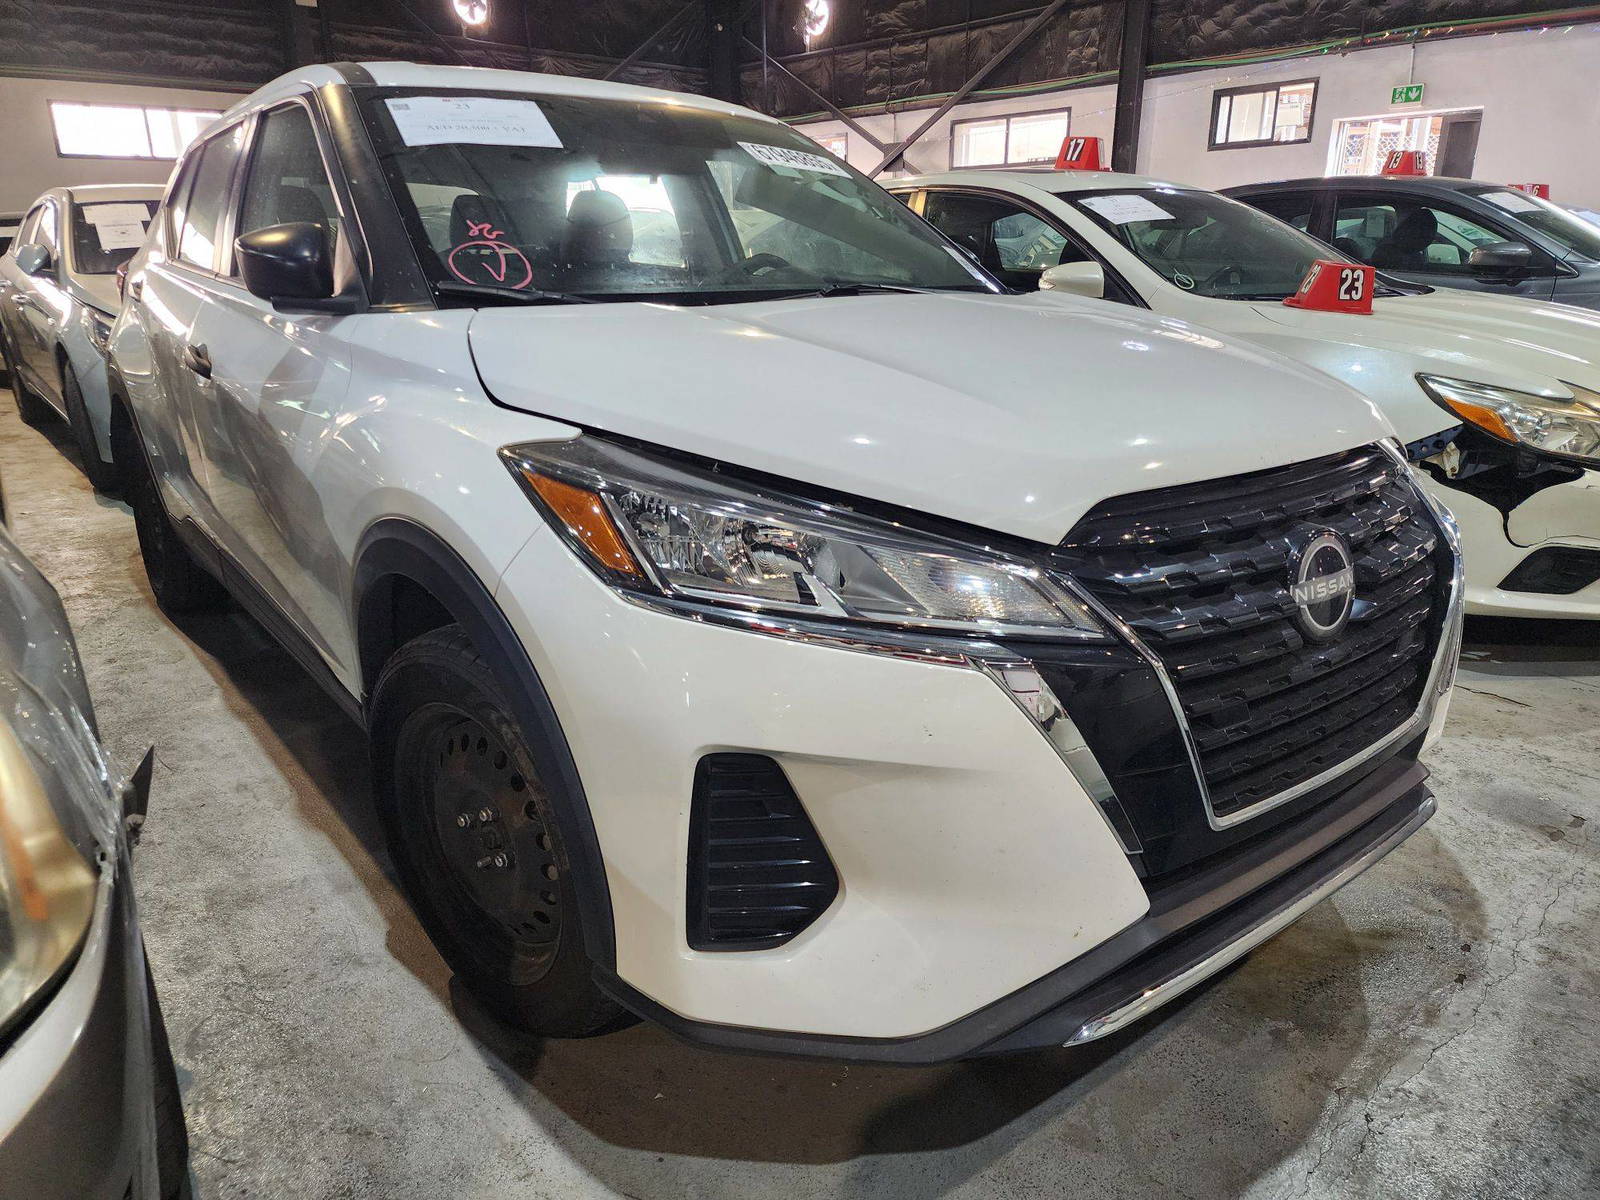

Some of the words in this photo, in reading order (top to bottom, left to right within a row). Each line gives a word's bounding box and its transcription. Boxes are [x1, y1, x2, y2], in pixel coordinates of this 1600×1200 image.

[1066, 138, 1085, 161] 17
[1388, 151, 1403, 169] 13
[1339, 268, 1364, 301] 23
[1294, 573, 1355, 603] NISSAN
